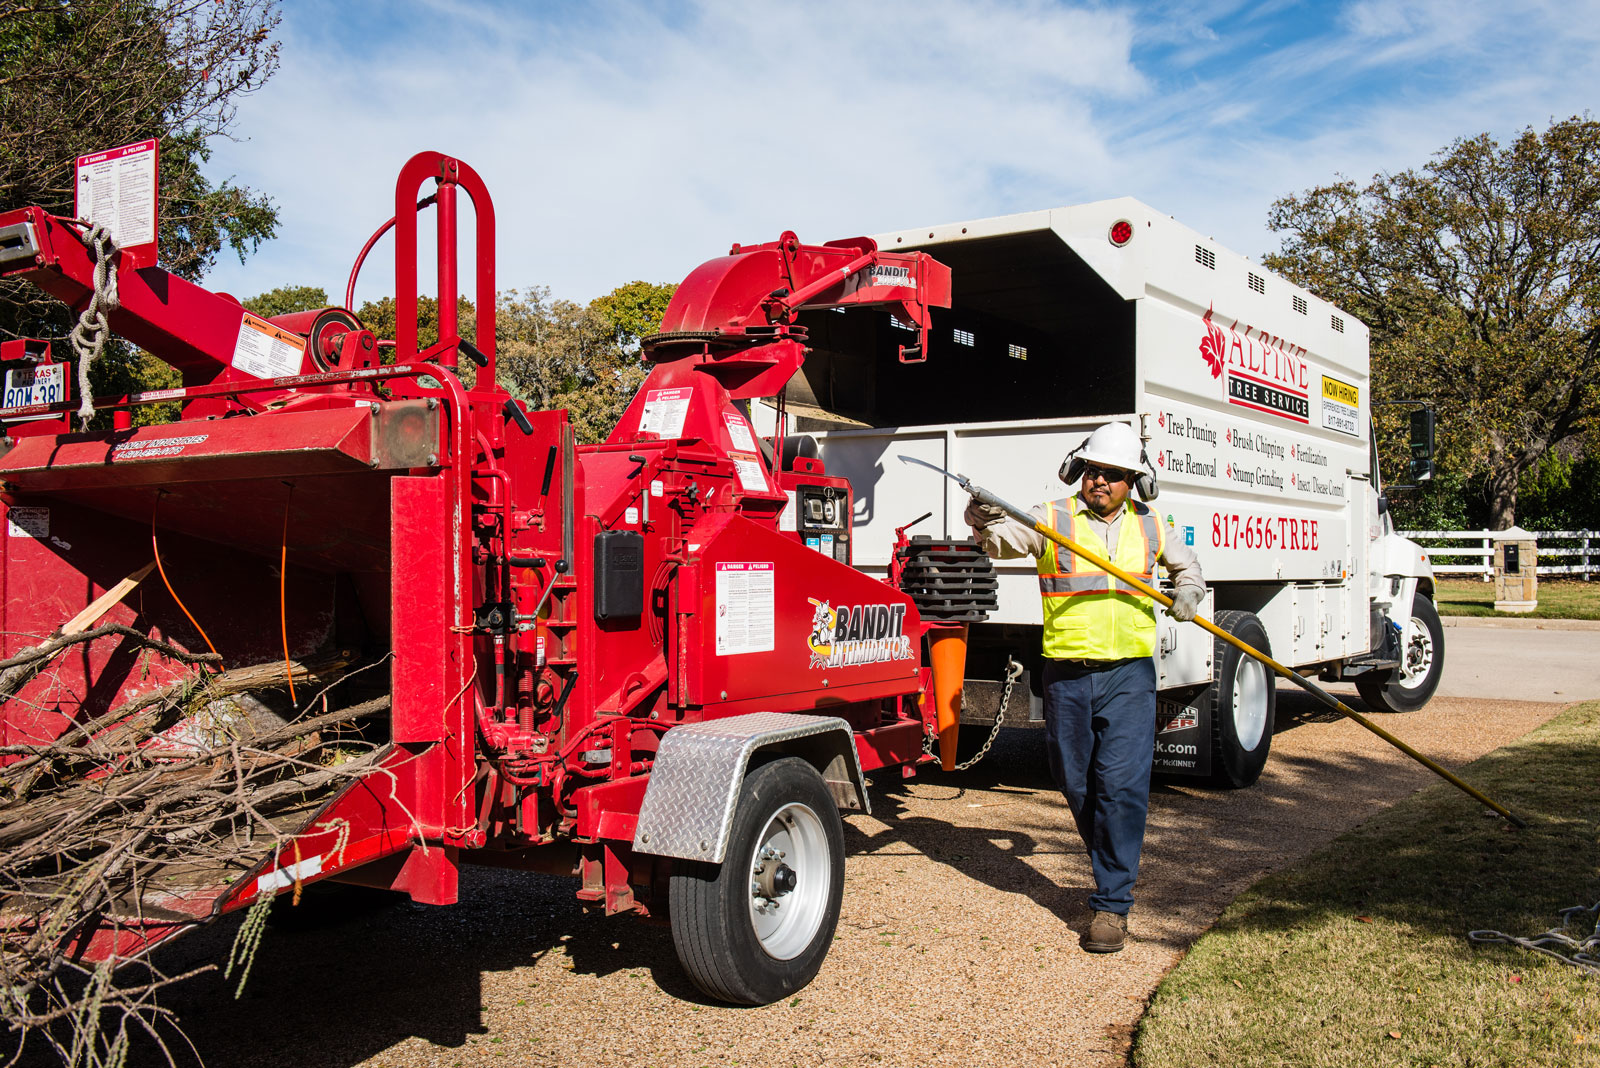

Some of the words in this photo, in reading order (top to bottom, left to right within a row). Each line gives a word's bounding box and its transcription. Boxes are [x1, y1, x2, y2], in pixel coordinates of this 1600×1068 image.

[89, 154, 107, 163] DANGER
[128, 144, 147, 154] PELIGRO
[869, 264, 909, 278] BANDIT
[1228, 319, 1309, 390] ALPINE
[23, 368, 51, 380] TEXAS
[1229, 379, 1258, 400] TREE
[1264, 390, 1307, 415] SERVICE
[1324, 381, 1338, 397] NOW
[1339, 385, 1357, 404] HIRING
[1166, 412, 1184, 437] Tree
[1186, 417, 1217, 448] Pruning
[1232, 428, 1254, 451] Brush
[1255, 434, 1285, 461] Chipping
[1166, 449, 1184, 473] Tree
[1185, 453, 1217, 478] Removal
[1296, 443, 1328, 467] Fertilization
[1232, 462, 1255, 488] Stump
[1255, 466, 1284, 492] Grinding
[1328, 479, 1345, 497] Control
[1212, 512, 1319, 551] 817-656-TREE
[834, 603, 906, 643] BANDIT
[826, 635, 910, 669] INTIMIDATOR
[1162, 758, 1197, 769] McKINNEY
